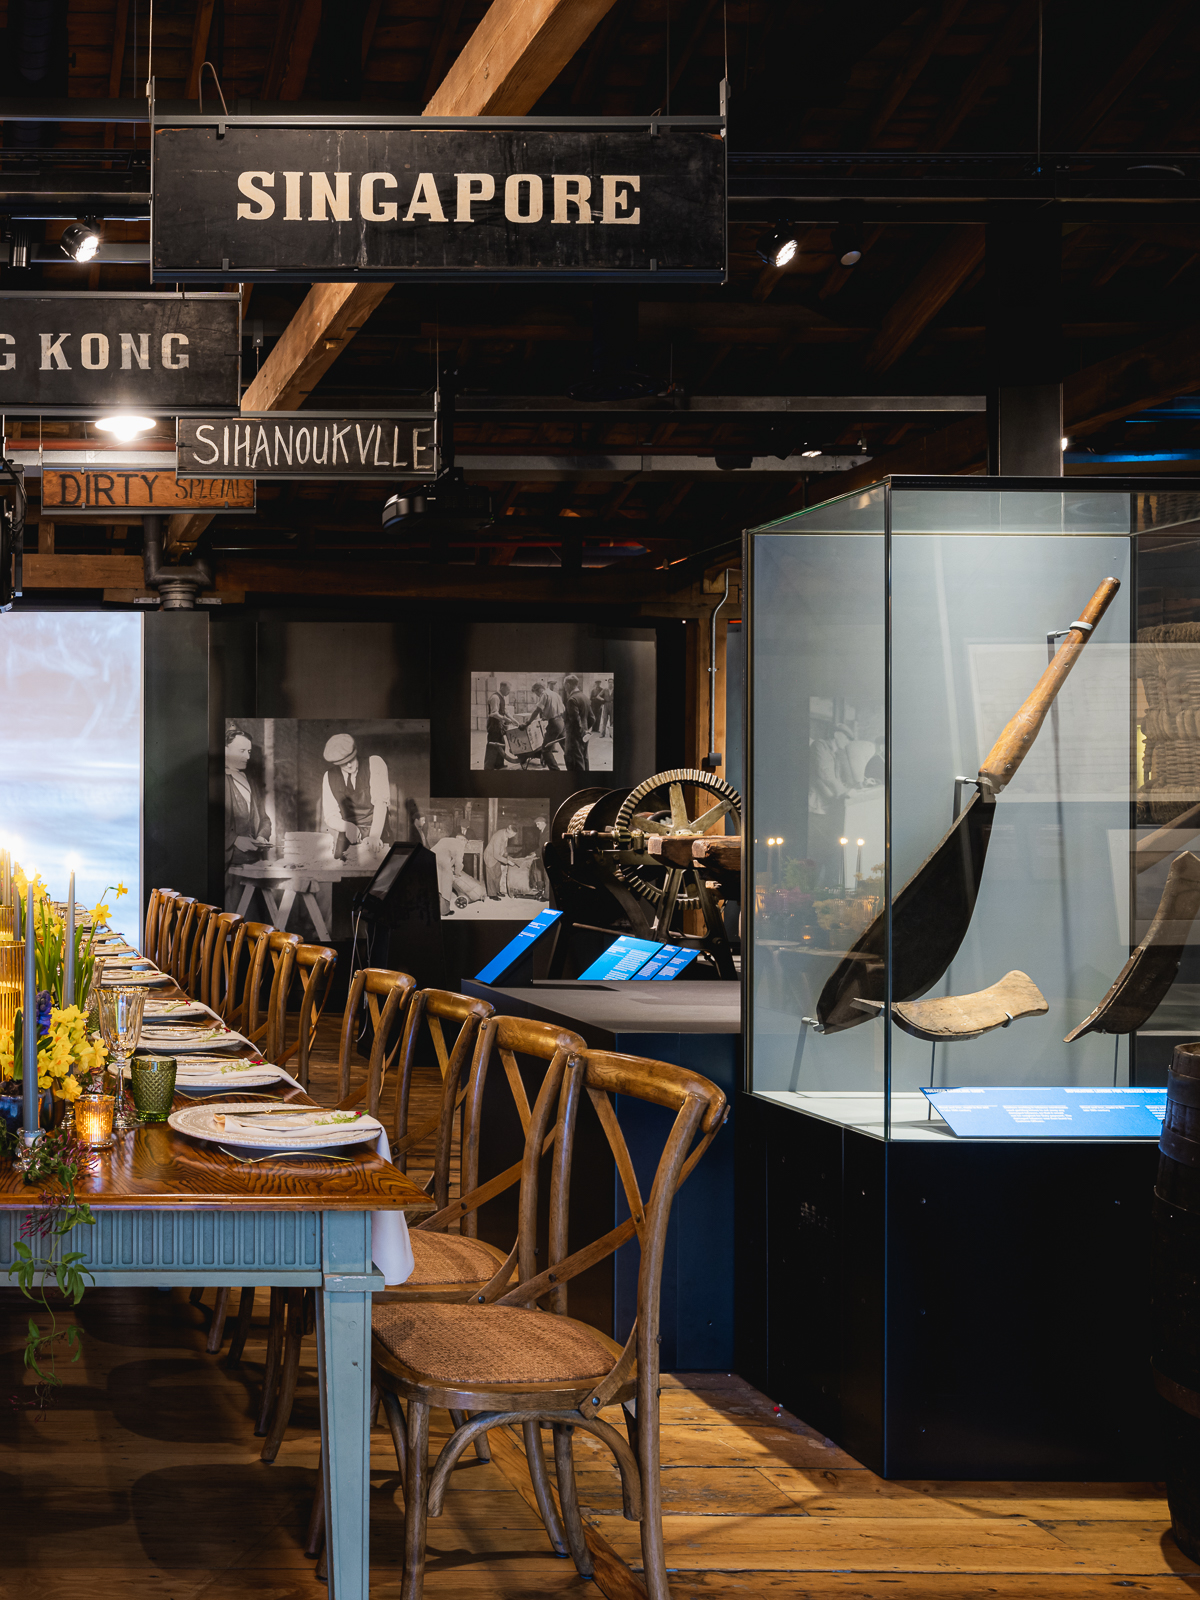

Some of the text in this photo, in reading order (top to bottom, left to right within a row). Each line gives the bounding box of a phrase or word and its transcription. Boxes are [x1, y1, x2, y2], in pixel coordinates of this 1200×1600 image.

[237, 170, 641, 225] SINGAPORE
[38, 332, 190, 371] KONG
[193, 423, 434, 470] SIHANOUKVLLE
[59, 473, 159, 506] DIRTY
